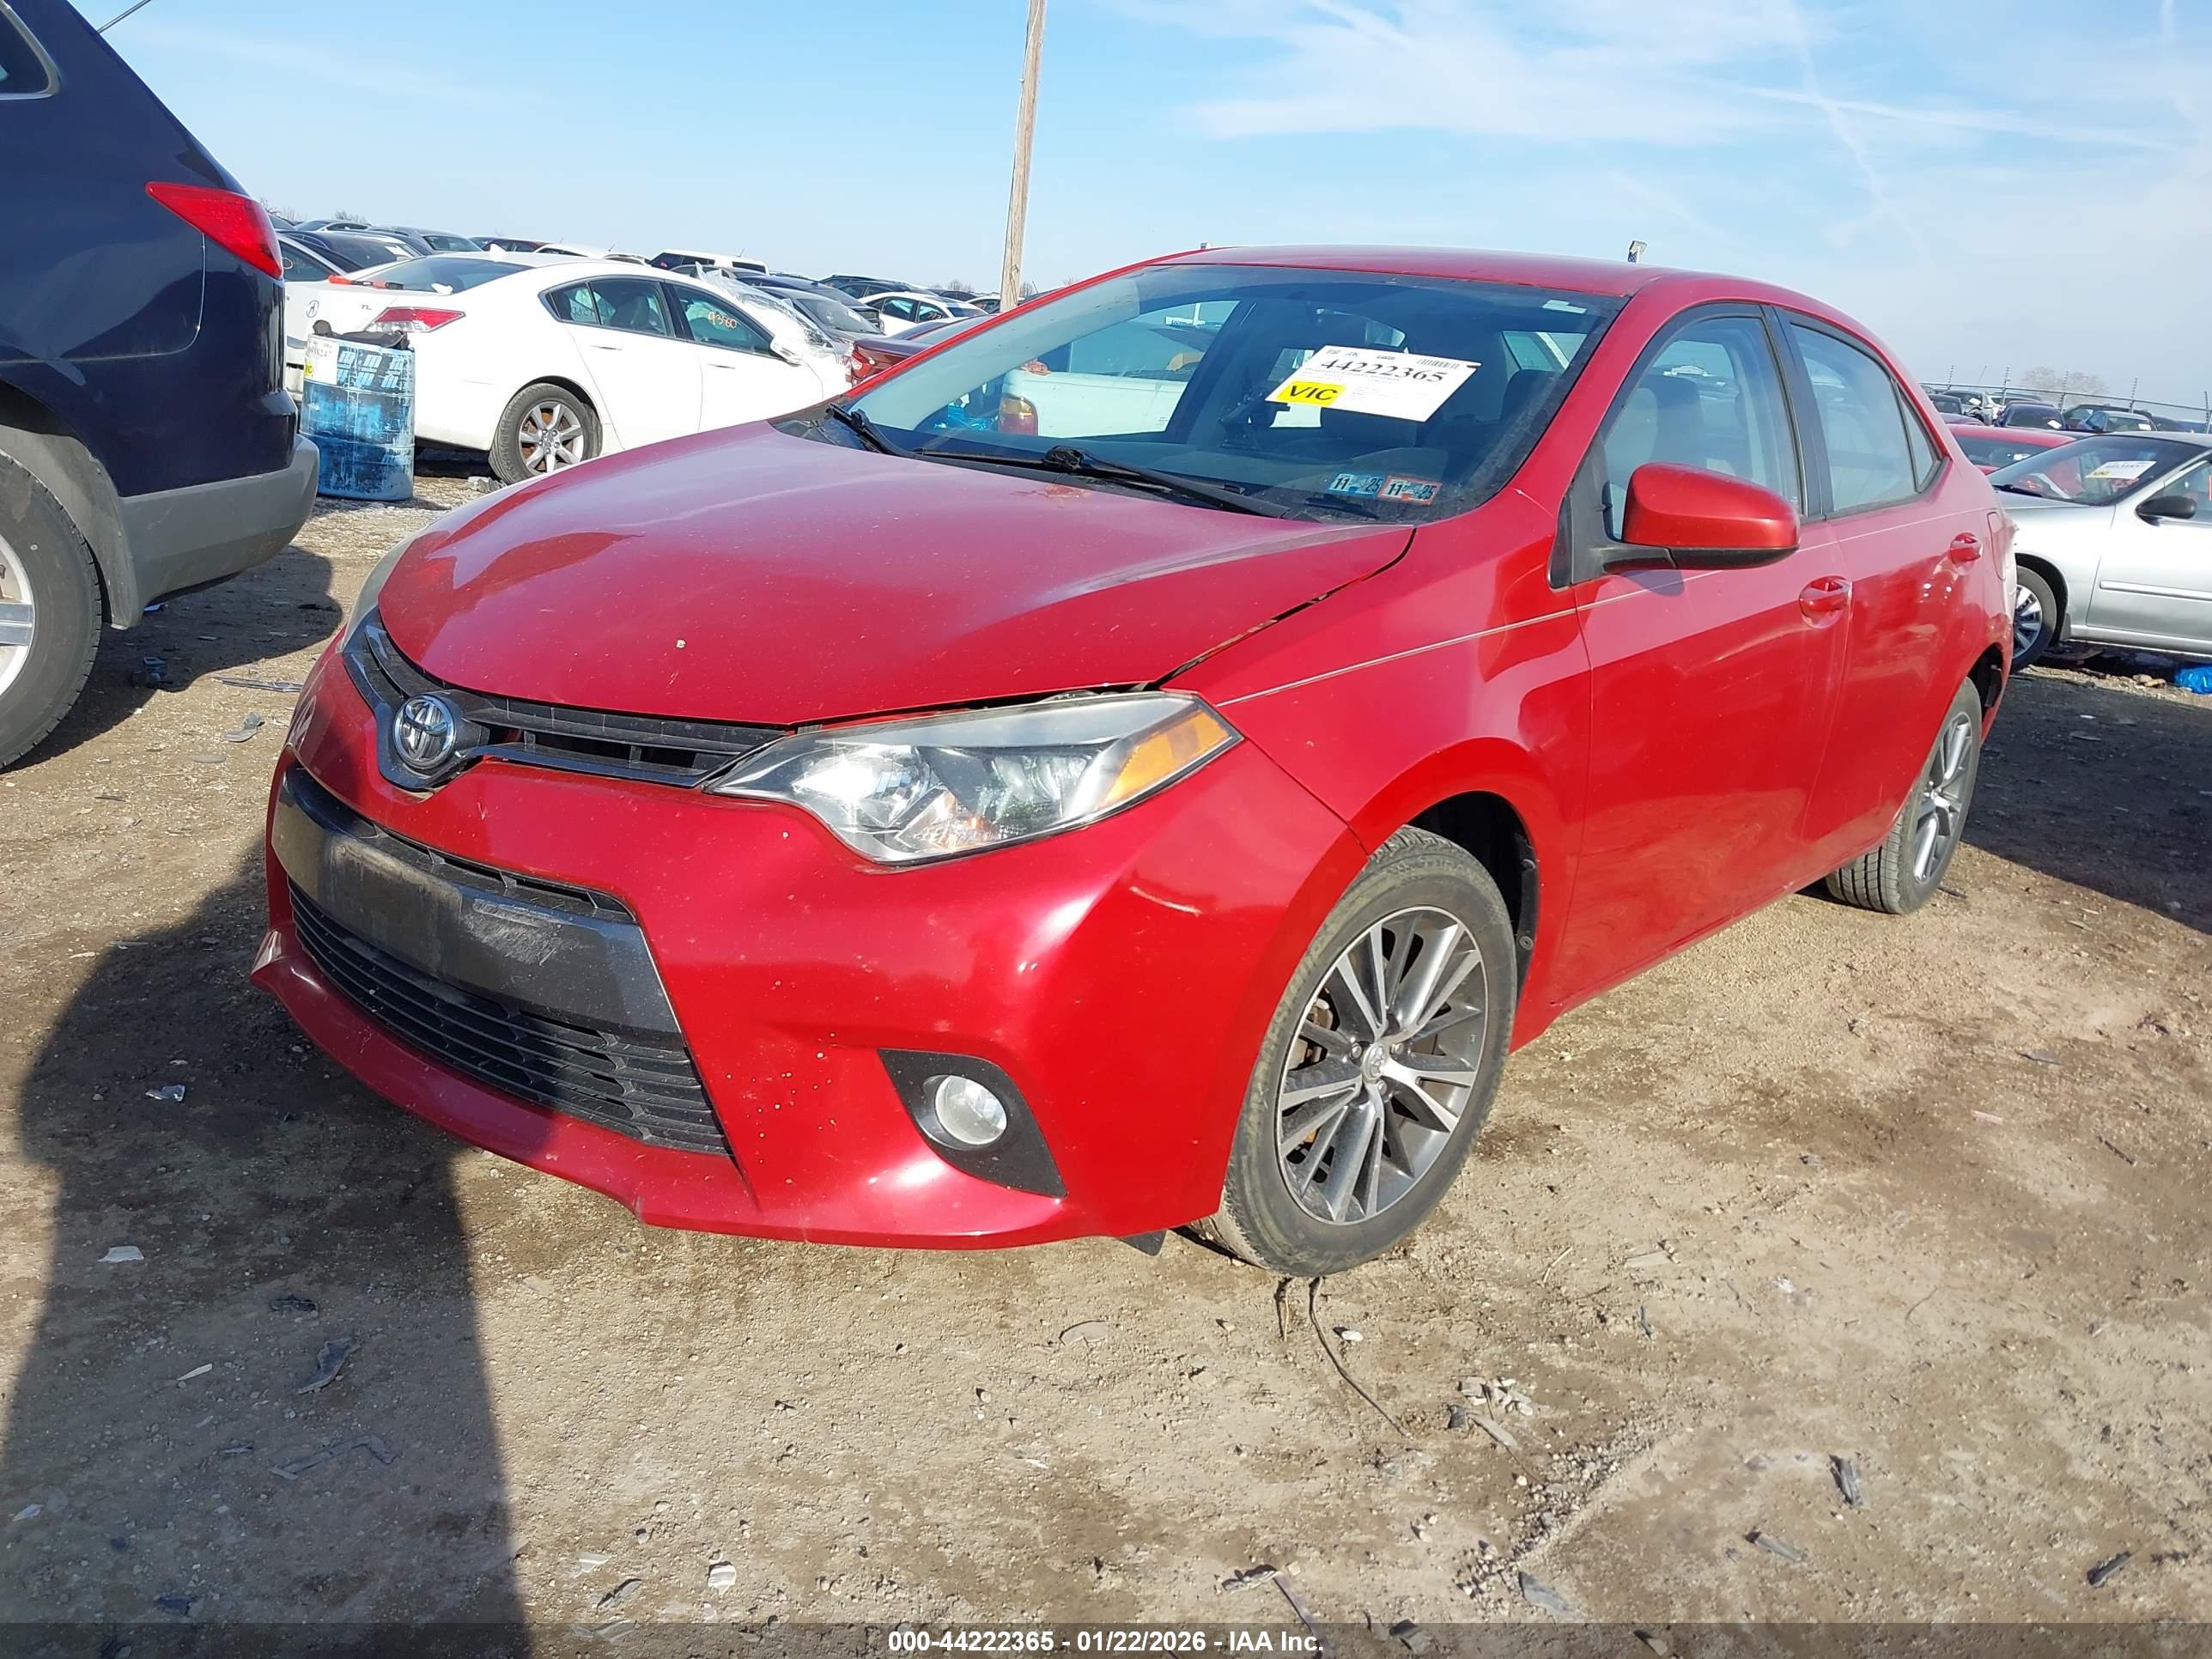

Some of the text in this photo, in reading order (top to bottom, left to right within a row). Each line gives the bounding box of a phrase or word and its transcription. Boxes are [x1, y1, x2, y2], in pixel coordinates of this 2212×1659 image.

[1321, 359, 1449, 382] 44222365
[1289, 385, 1339, 401] VIC
[1333, 477, 1383, 492] 11 25
[1387, 483, 1404, 496] 11
